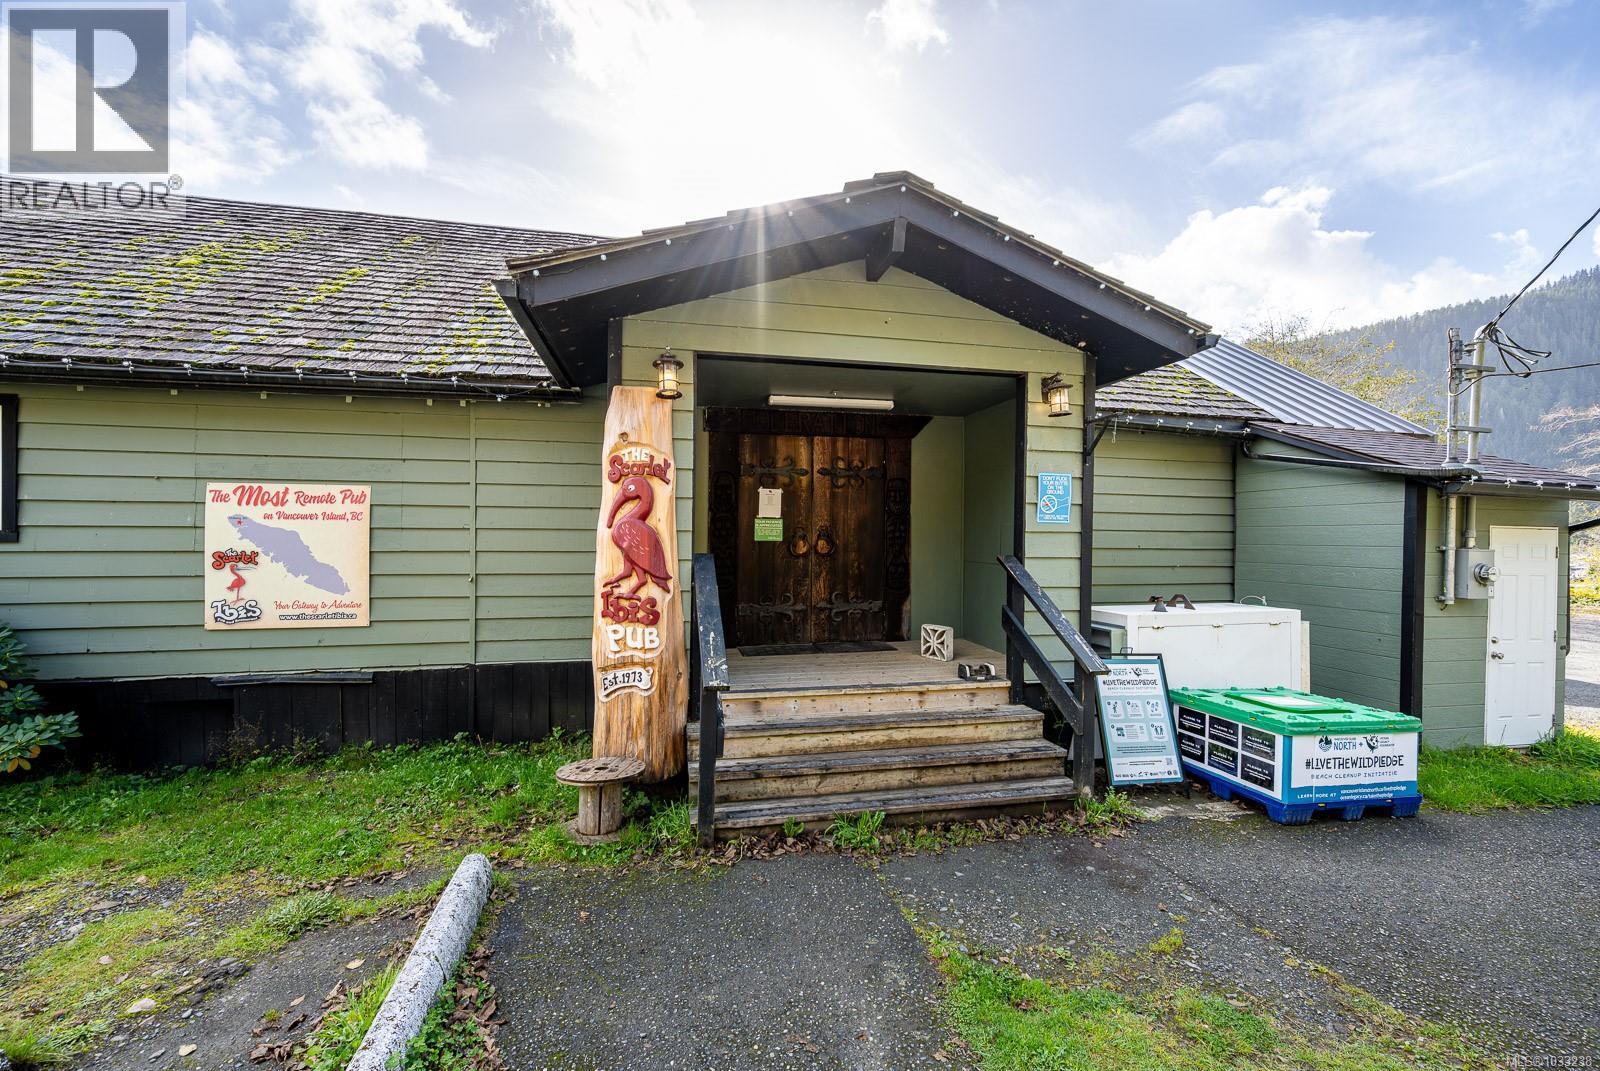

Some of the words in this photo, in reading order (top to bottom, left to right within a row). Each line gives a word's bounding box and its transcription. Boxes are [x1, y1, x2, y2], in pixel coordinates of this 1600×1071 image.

[621, 447, 650, 462] THE
[607, 454, 672, 485] Scarlet
[208, 489, 231, 503] The
[232, 484, 290, 508] Most
[294, 490, 337, 506] Remote
[339, 488, 367, 506] Pub
[263, 512, 273, 520] on
[275, 511, 319, 521] Vancouver
[320, 511, 349, 522] Island,
[350, 512, 363, 521] BC
[211, 551, 259, 570] Scarlet
[273, 600, 290, 610] Your
[291, 599, 319, 614] Gateway
[320, 600, 327, 609] to
[328, 599, 362, 609] Adventure
[278, 611, 358, 621] www.thescarletibis.ca
[605, 624, 660, 652] PUB
[1333, 741, 1357, 751] NORTH
[1305, 754, 1405, 770] #LIVETHEWILDPLEDGE
[1364, 770, 1398, 778] INITIATIVE
